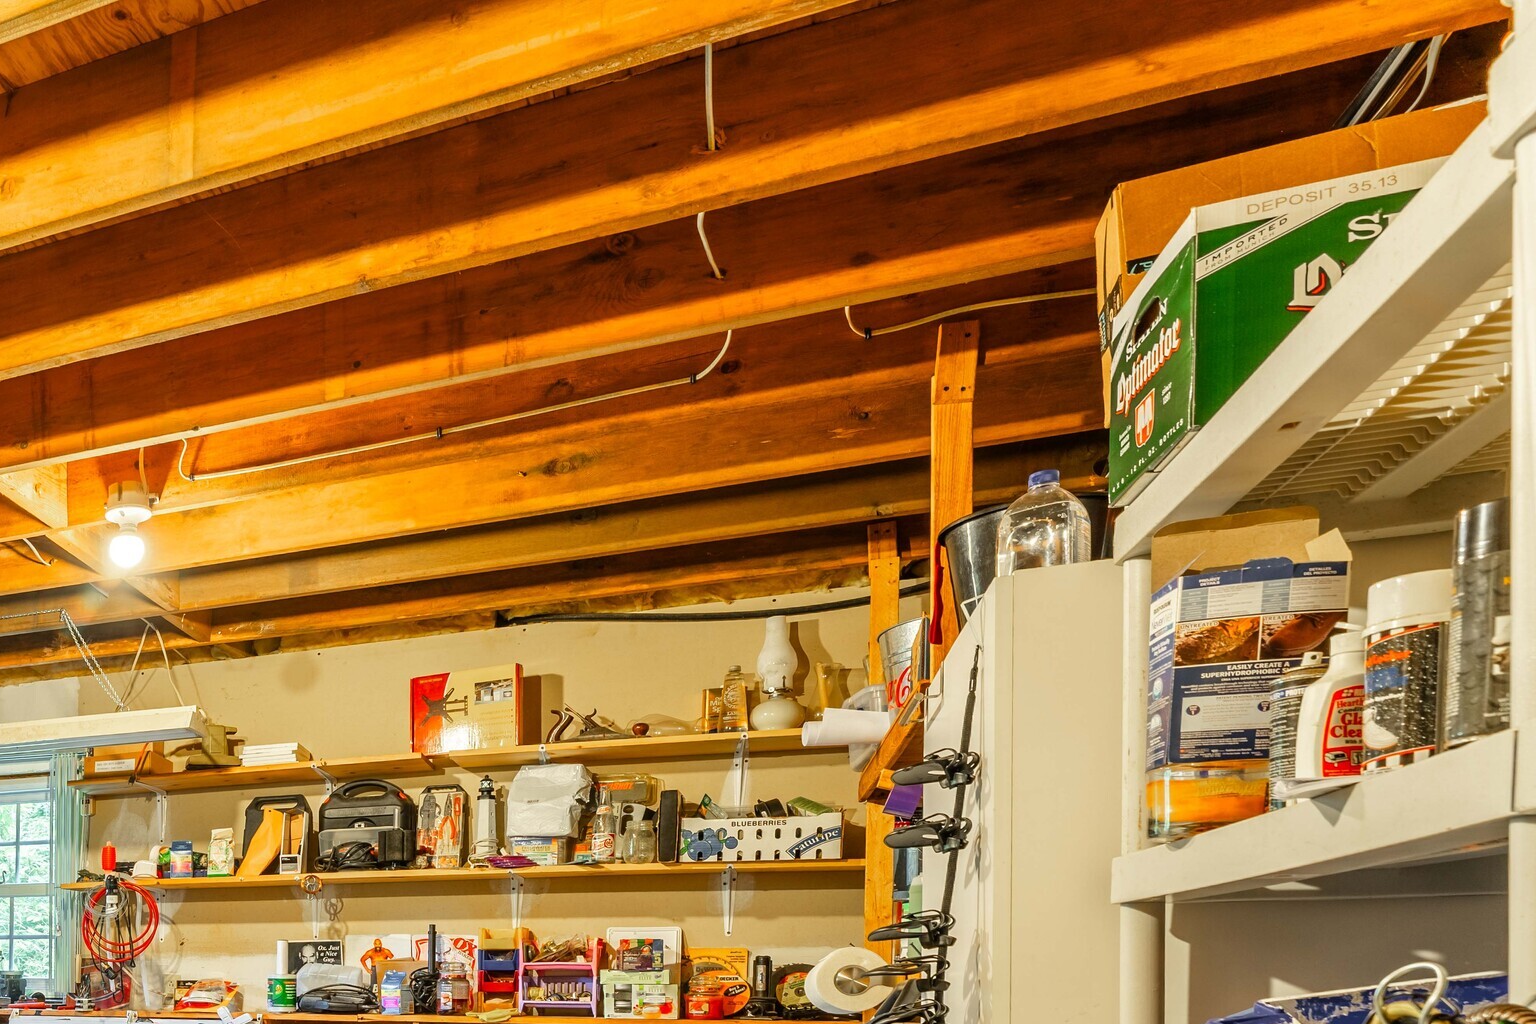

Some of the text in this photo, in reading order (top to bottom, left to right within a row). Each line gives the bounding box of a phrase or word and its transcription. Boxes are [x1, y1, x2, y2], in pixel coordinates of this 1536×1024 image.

[1246, 174, 1399, 216] DEPOSIT 35.13
[1204, 216, 1289, 267] IMPORTED
[1204, 231, 1276, 271] FROM MUNICH
[1116, 317, 1182, 418] Optimator
[1179, 620, 1219, 631] UNTREATED
[1226, 663, 1253, 671] EASILY
[1254, 662, 1282, 670] CREATE
[1200, 668, 1281, 679] SUPERHYDROPHOBIC
[1340, 712, 1364, 726] Gla
[1330, 725, 1363, 738] Clea
[730, 819, 787, 828] BLUEBERRIES
